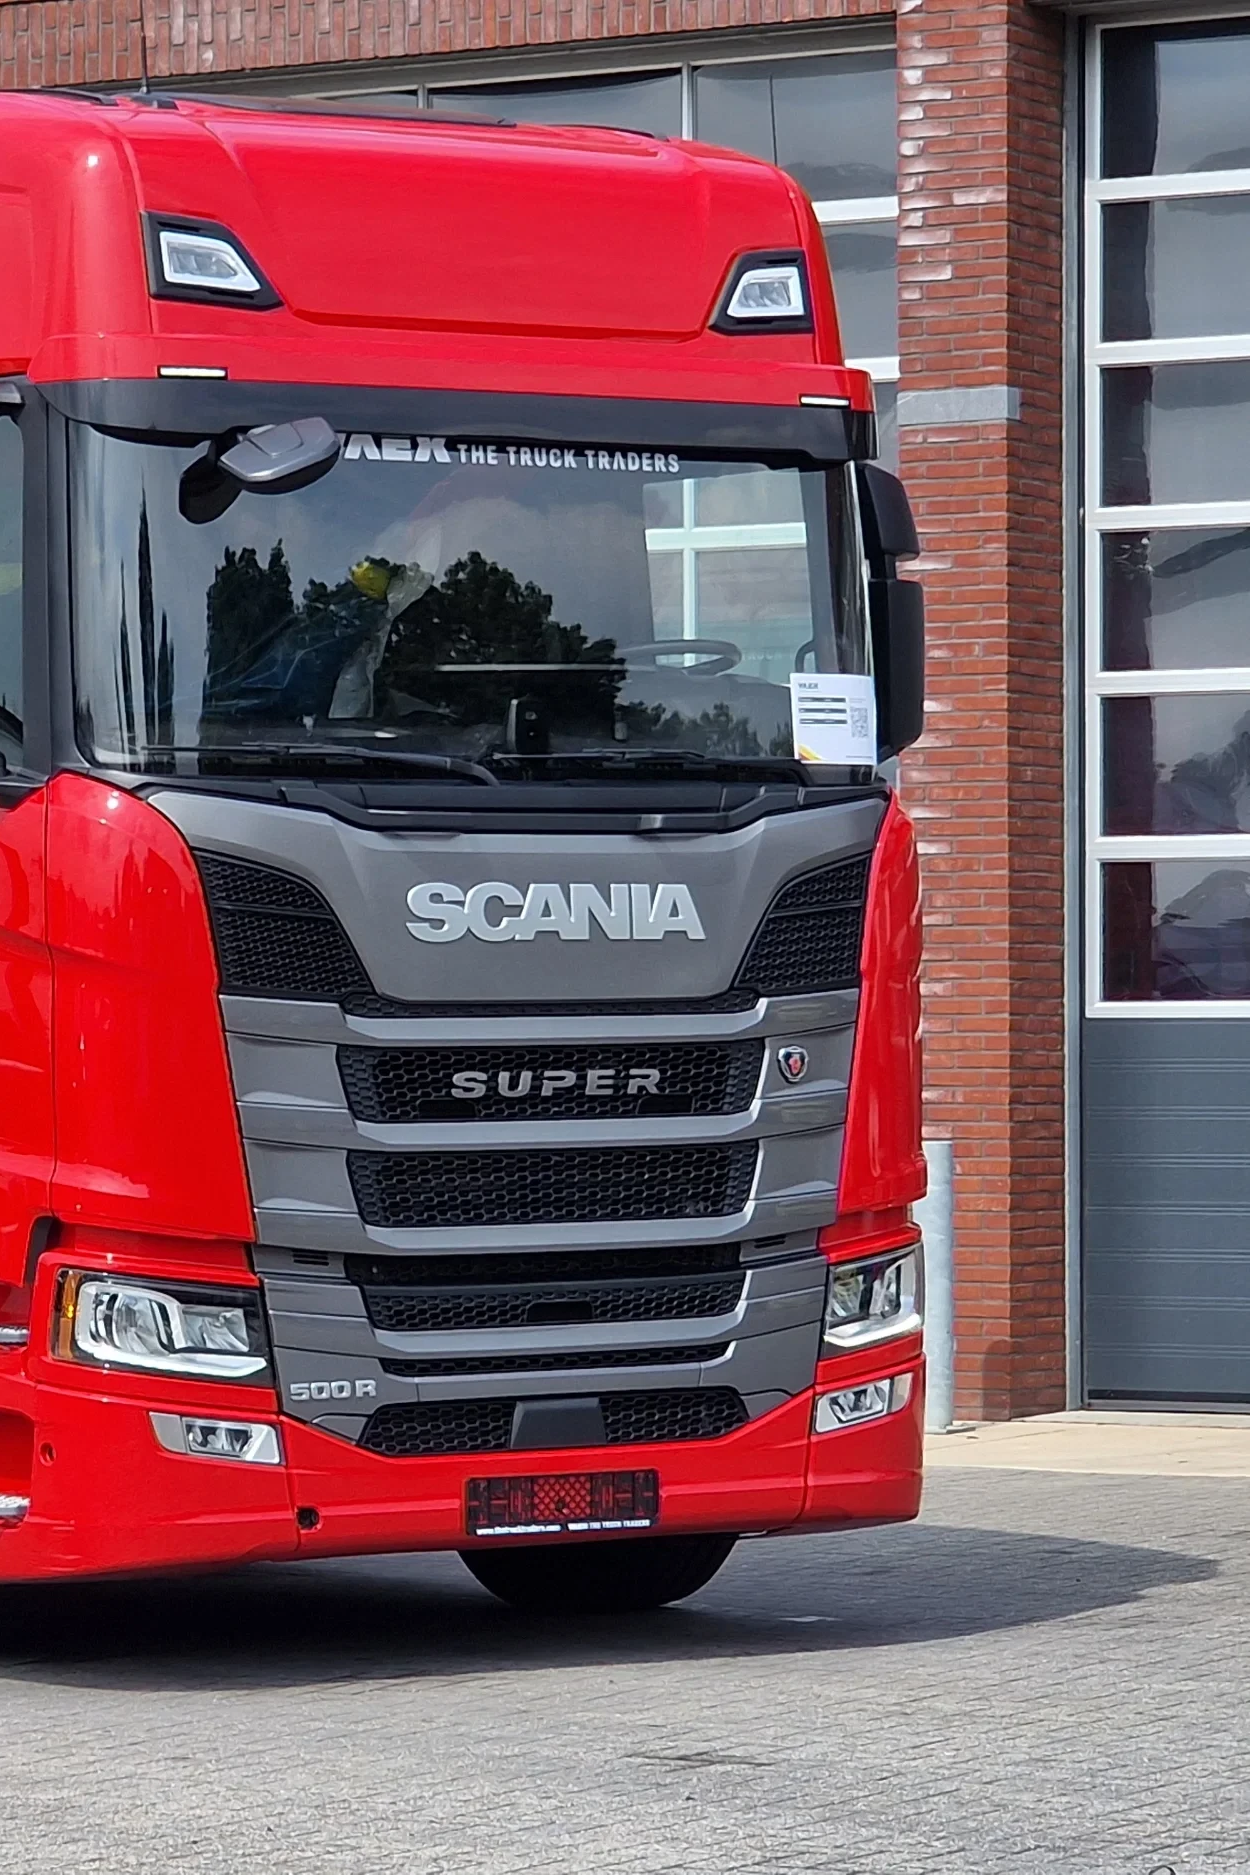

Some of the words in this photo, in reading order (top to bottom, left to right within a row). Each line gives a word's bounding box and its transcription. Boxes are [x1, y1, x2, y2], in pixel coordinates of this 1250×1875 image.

[338, 433, 452, 464] AEX
[456, 443, 499, 466] THE
[506, 446, 578, 469] TRUCK
[584, 450, 680, 473] TRADERS
[405, 882, 707, 943] SCANIA
[451, 1068, 662, 1099] SUPER
[290, 1380, 351, 1400] 500
[355, 1379, 377, 1398] R
